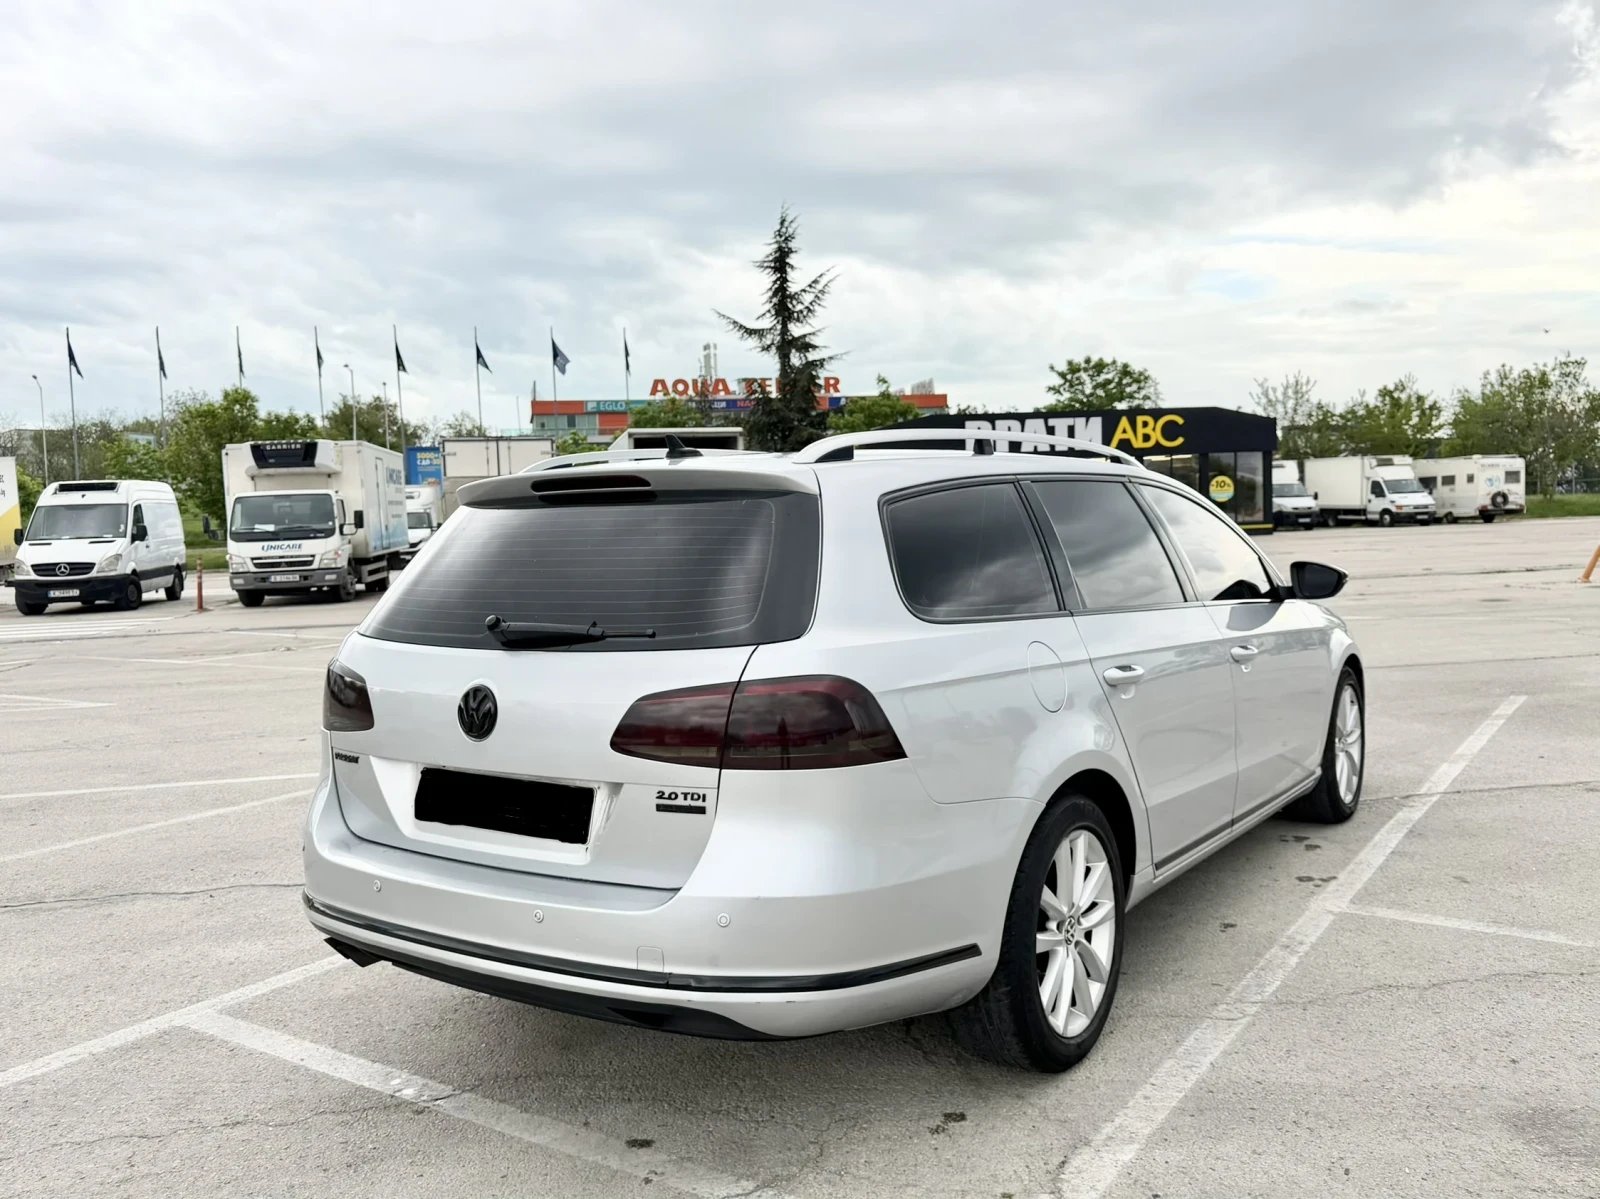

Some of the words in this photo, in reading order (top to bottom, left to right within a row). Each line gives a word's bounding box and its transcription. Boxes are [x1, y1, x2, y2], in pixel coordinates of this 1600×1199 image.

[650, 378, 731, 396] AQUA
[600, 401, 626, 412] EGLO
[1110, 414, 1185, 449] ABC
[261, 543, 303, 552] UNICARE
[680, 791, 707, 803] TDI
